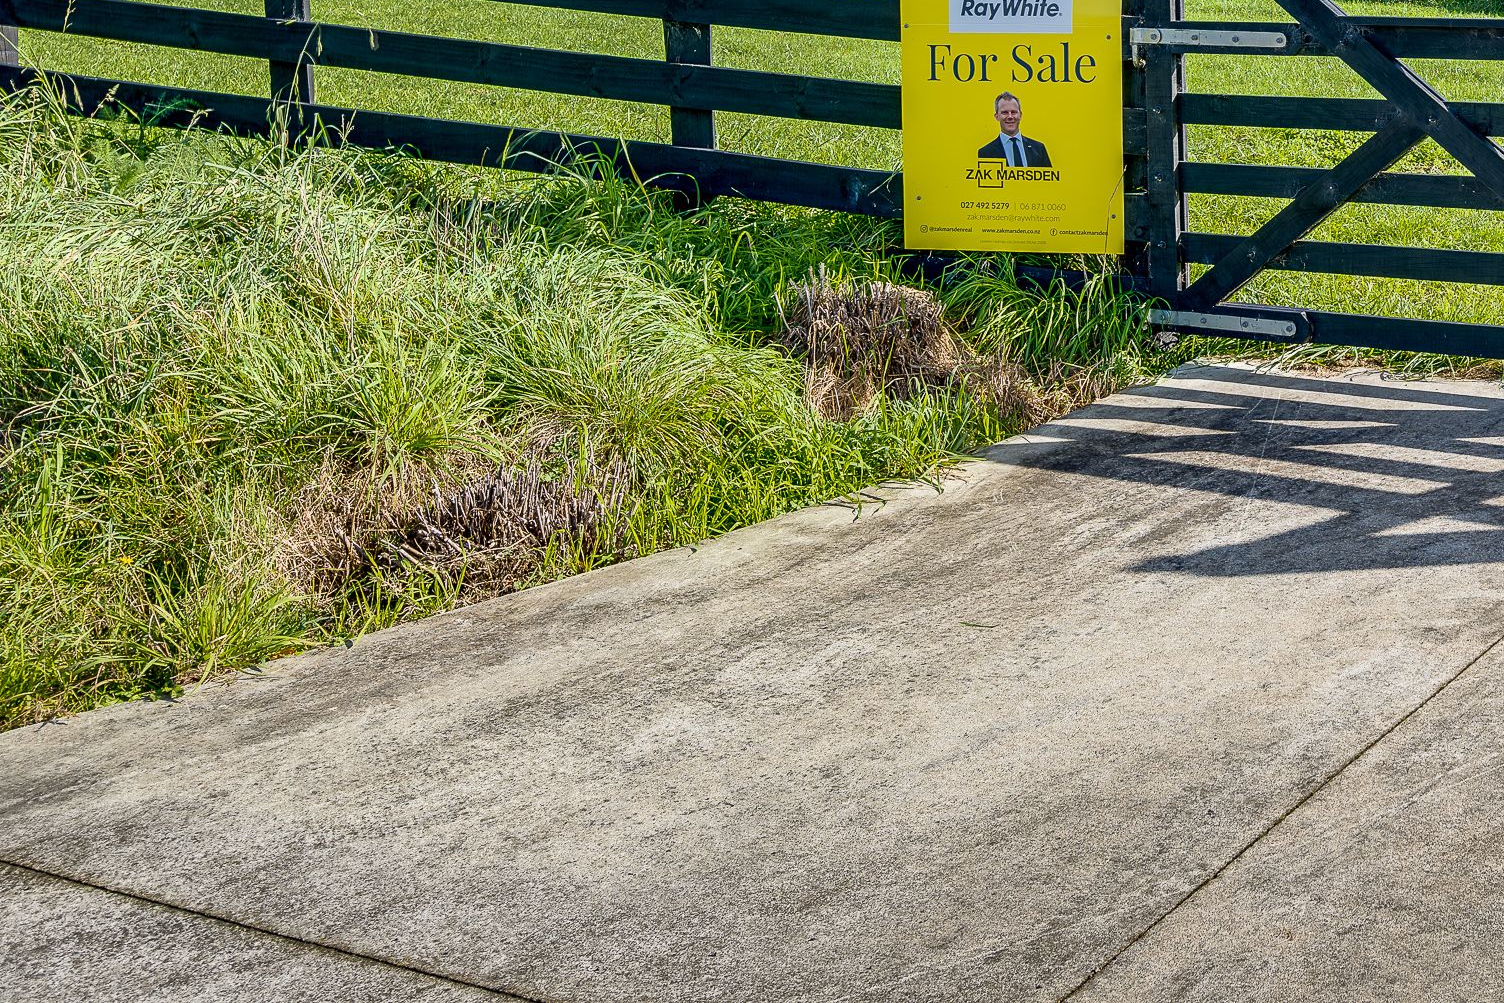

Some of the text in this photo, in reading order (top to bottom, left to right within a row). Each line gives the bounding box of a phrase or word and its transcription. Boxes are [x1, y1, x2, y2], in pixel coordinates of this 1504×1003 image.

[927, 42, 1097, 83] For Sale
[965, 169, 1060, 181] ZAK MARSDEN
[960, 201, 1010, 210] 027 492 5279
[1020, 202, 1030, 210] 06
[1031, 203, 1045, 211] 871
[967, 213, 1060, 222] zak.marsden@raywhite.com
